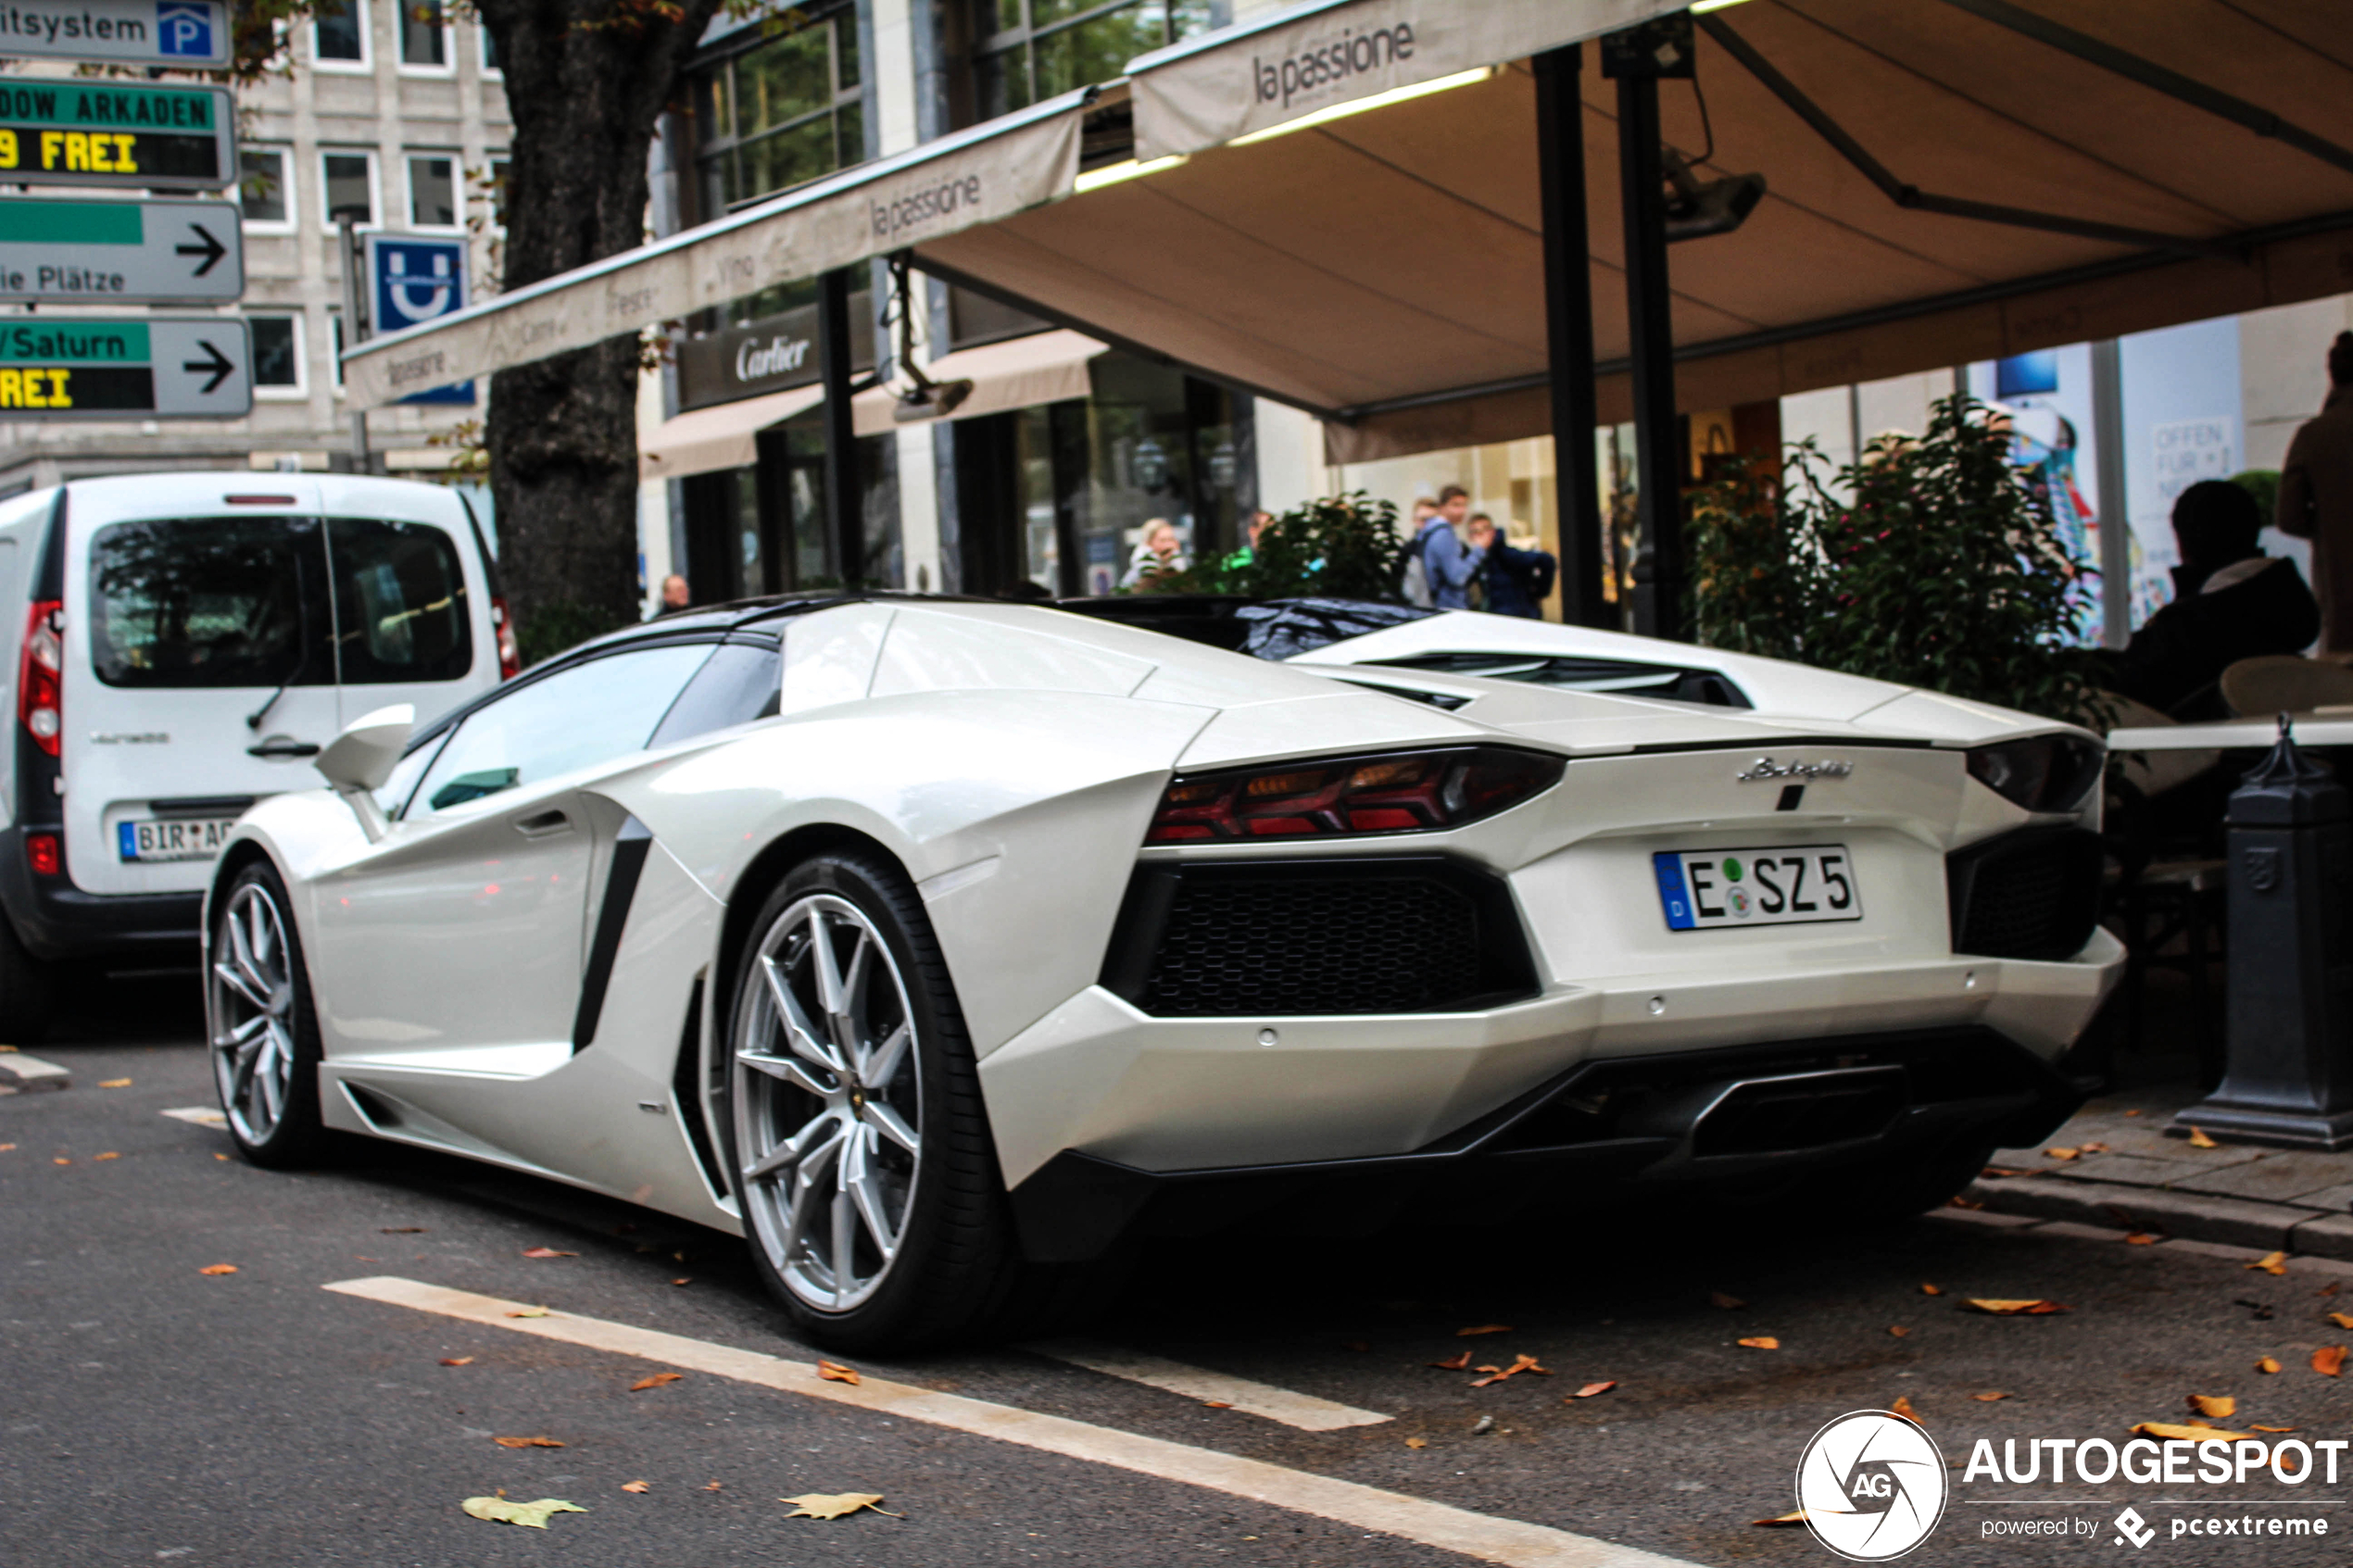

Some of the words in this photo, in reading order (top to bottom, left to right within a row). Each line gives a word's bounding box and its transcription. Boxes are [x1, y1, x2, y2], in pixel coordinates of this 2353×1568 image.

[0, 4, 145, 43] itsystem
[77, 92, 207, 127] ARKADEN
[41, 131, 138, 173] FREI
[37, 265, 125, 292] Plätze
[736, 335, 811, 382] Cartier
[0, 368, 72, 408] REI
[139, 823, 184, 851] BIR
[1689, 861, 1726, 918] E
